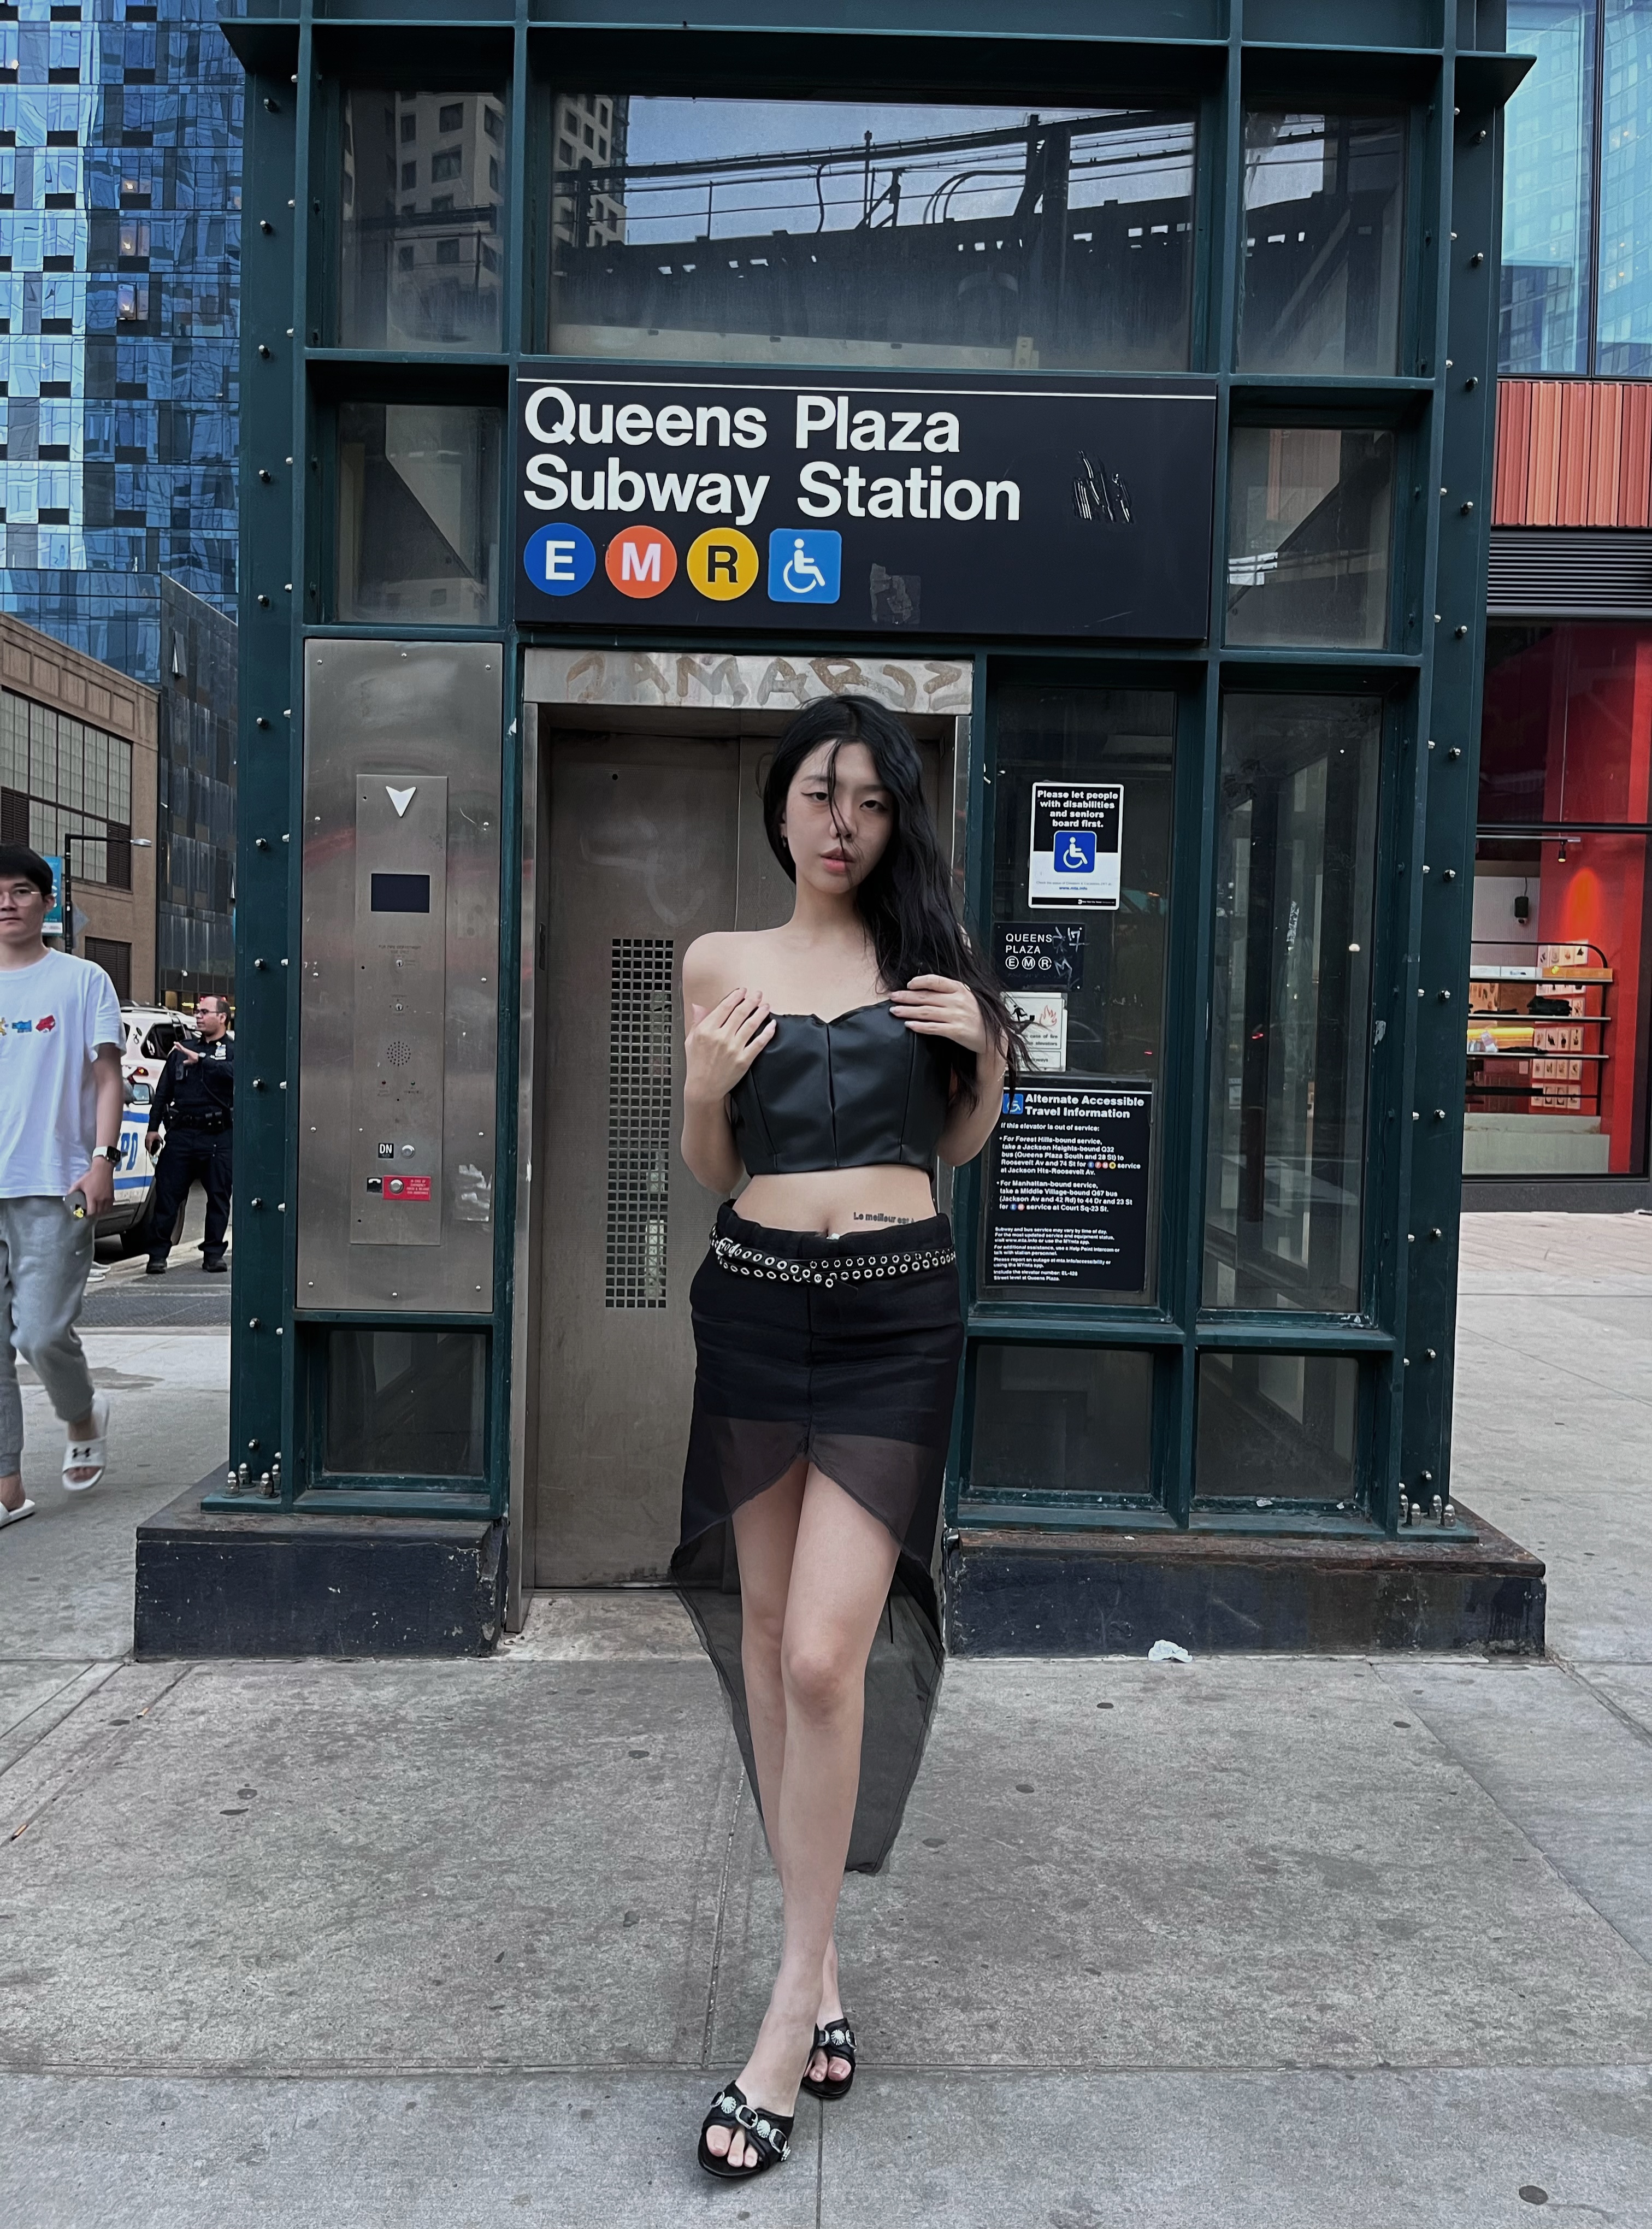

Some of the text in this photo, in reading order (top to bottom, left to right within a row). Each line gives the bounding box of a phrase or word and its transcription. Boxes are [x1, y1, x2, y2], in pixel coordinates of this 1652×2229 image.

[525, 387, 960, 453] Queens Plaza
[524, 453, 770, 525] Subway
[797, 461, 1020, 521] Station
[545, 540, 738, 583] E M R
[1071, 791, 1084, 799] let
[1087, 792, 1118, 800] people
[1006, 933, 1052, 943] QUEENS
[1005, 945, 1041, 954] PLAZA
[1008, 958, 1049, 968] E M R
[1025, 1094, 1144, 1106] Alternate Accessible
[1025, 1106, 1130, 1118] Travel Information
[379, 1143, 392, 1154] DN
[1052, 1145, 1100, 1153] Heights-bound
[865, 1213, 896, 1223] meilleur
